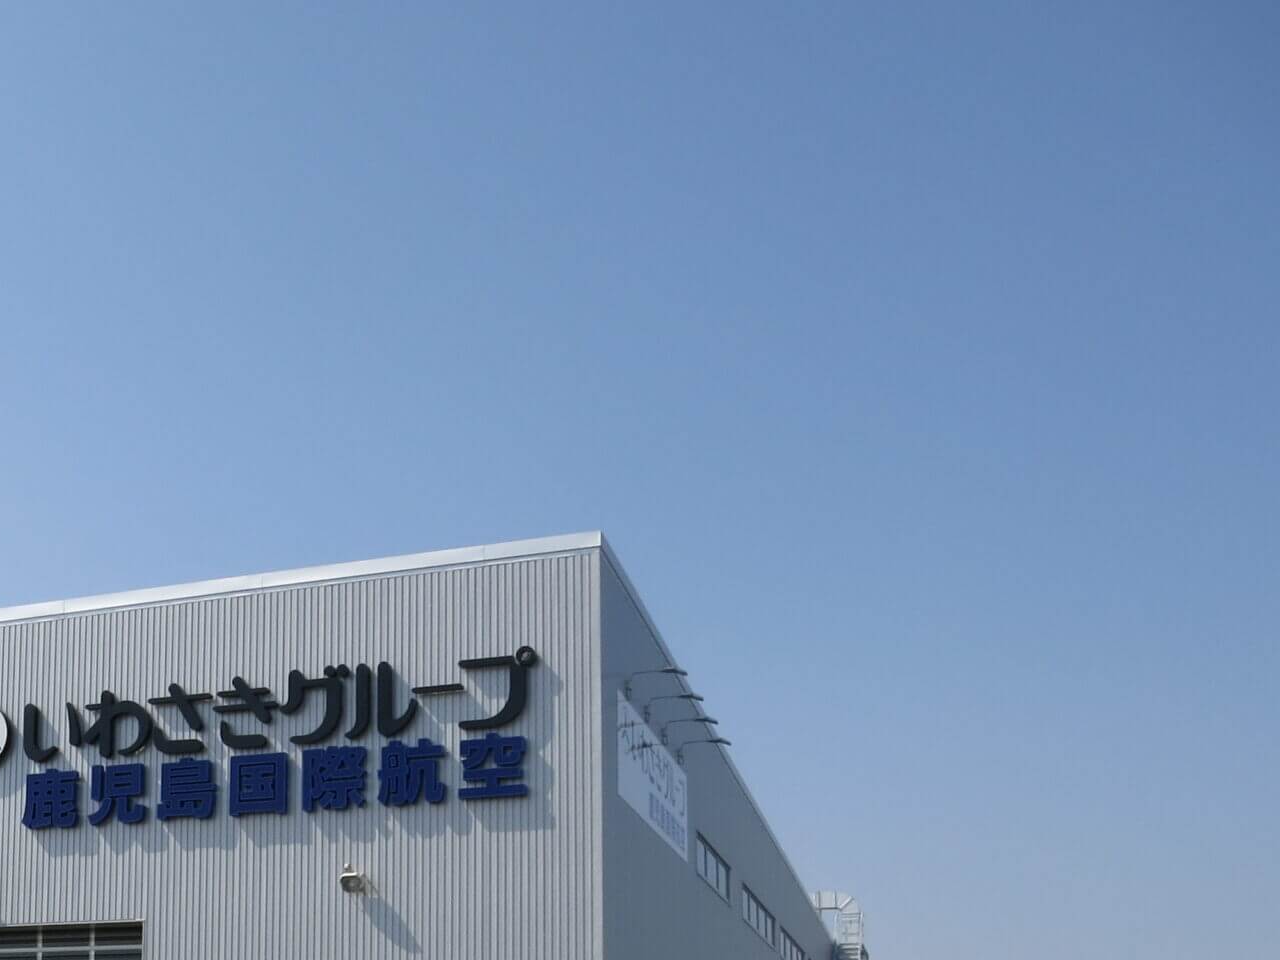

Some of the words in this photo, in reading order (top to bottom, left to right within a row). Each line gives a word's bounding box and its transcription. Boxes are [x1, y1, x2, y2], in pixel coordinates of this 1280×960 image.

[23, 646, 537, 763] いわさきグループ
[21, 733, 529, 830] 鹿児島国際航空
